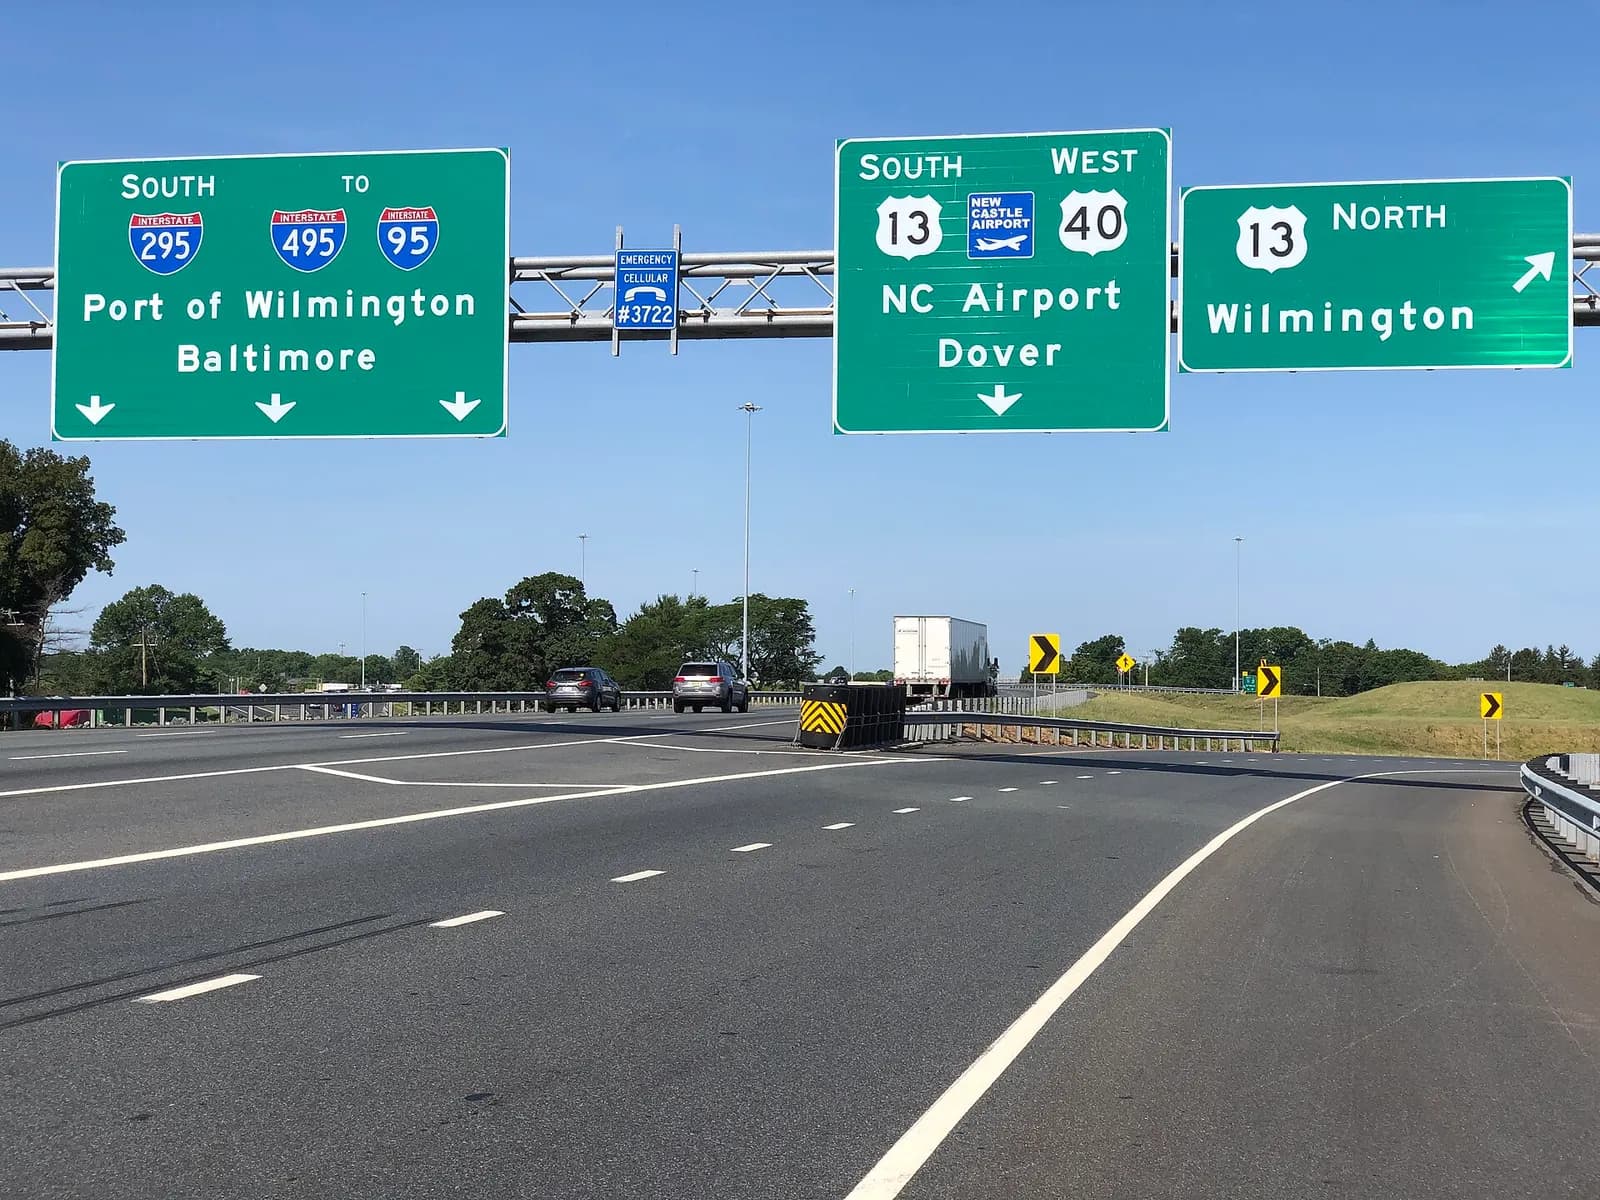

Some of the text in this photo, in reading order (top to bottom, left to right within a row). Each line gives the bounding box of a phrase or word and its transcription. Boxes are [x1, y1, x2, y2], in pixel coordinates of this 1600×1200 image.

[860, 154, 961, 180] SOUTH
[1052, 148, 1137, 174] WEST
[122, 174, 214, 198] SOUTH
[342, 176, 368, 192] TO
[388, 210, 429, 221] INTERSTATE
[971, 197, 1001, 208] NEW
[971, 208, 1023, 219] CASTLE
[138, 216, 194, 226] INTERSTATE
[280, 212, 337, 223] INTERSTATE
[889, 211, 929, 244] 13
[971, 218, 1031, 230] AIRPORT
[1065, 205, 1121, 240] 40
[1334, 203, 1445, 229] NORTH
[141, 231, 190, 261] 295
[282, 228, 335, 257] 495
[387, 226, 429, 255] 95
[1251, 222, 1293, 257] 13
[620, 255, 672, 265] EMERGENCY
[624, 273, 668, 283] CELLULAR
[84, 289, 473, 325] Port of Wilmington
[883, 280, 1120, 317] NC Airport
[619, 306, 672, 322] #3722
[1208, 301, 1472, 340] Wilmington
[179, 344, 375, 372] Baltimore
[939, 339, 1061, 367] Dover
